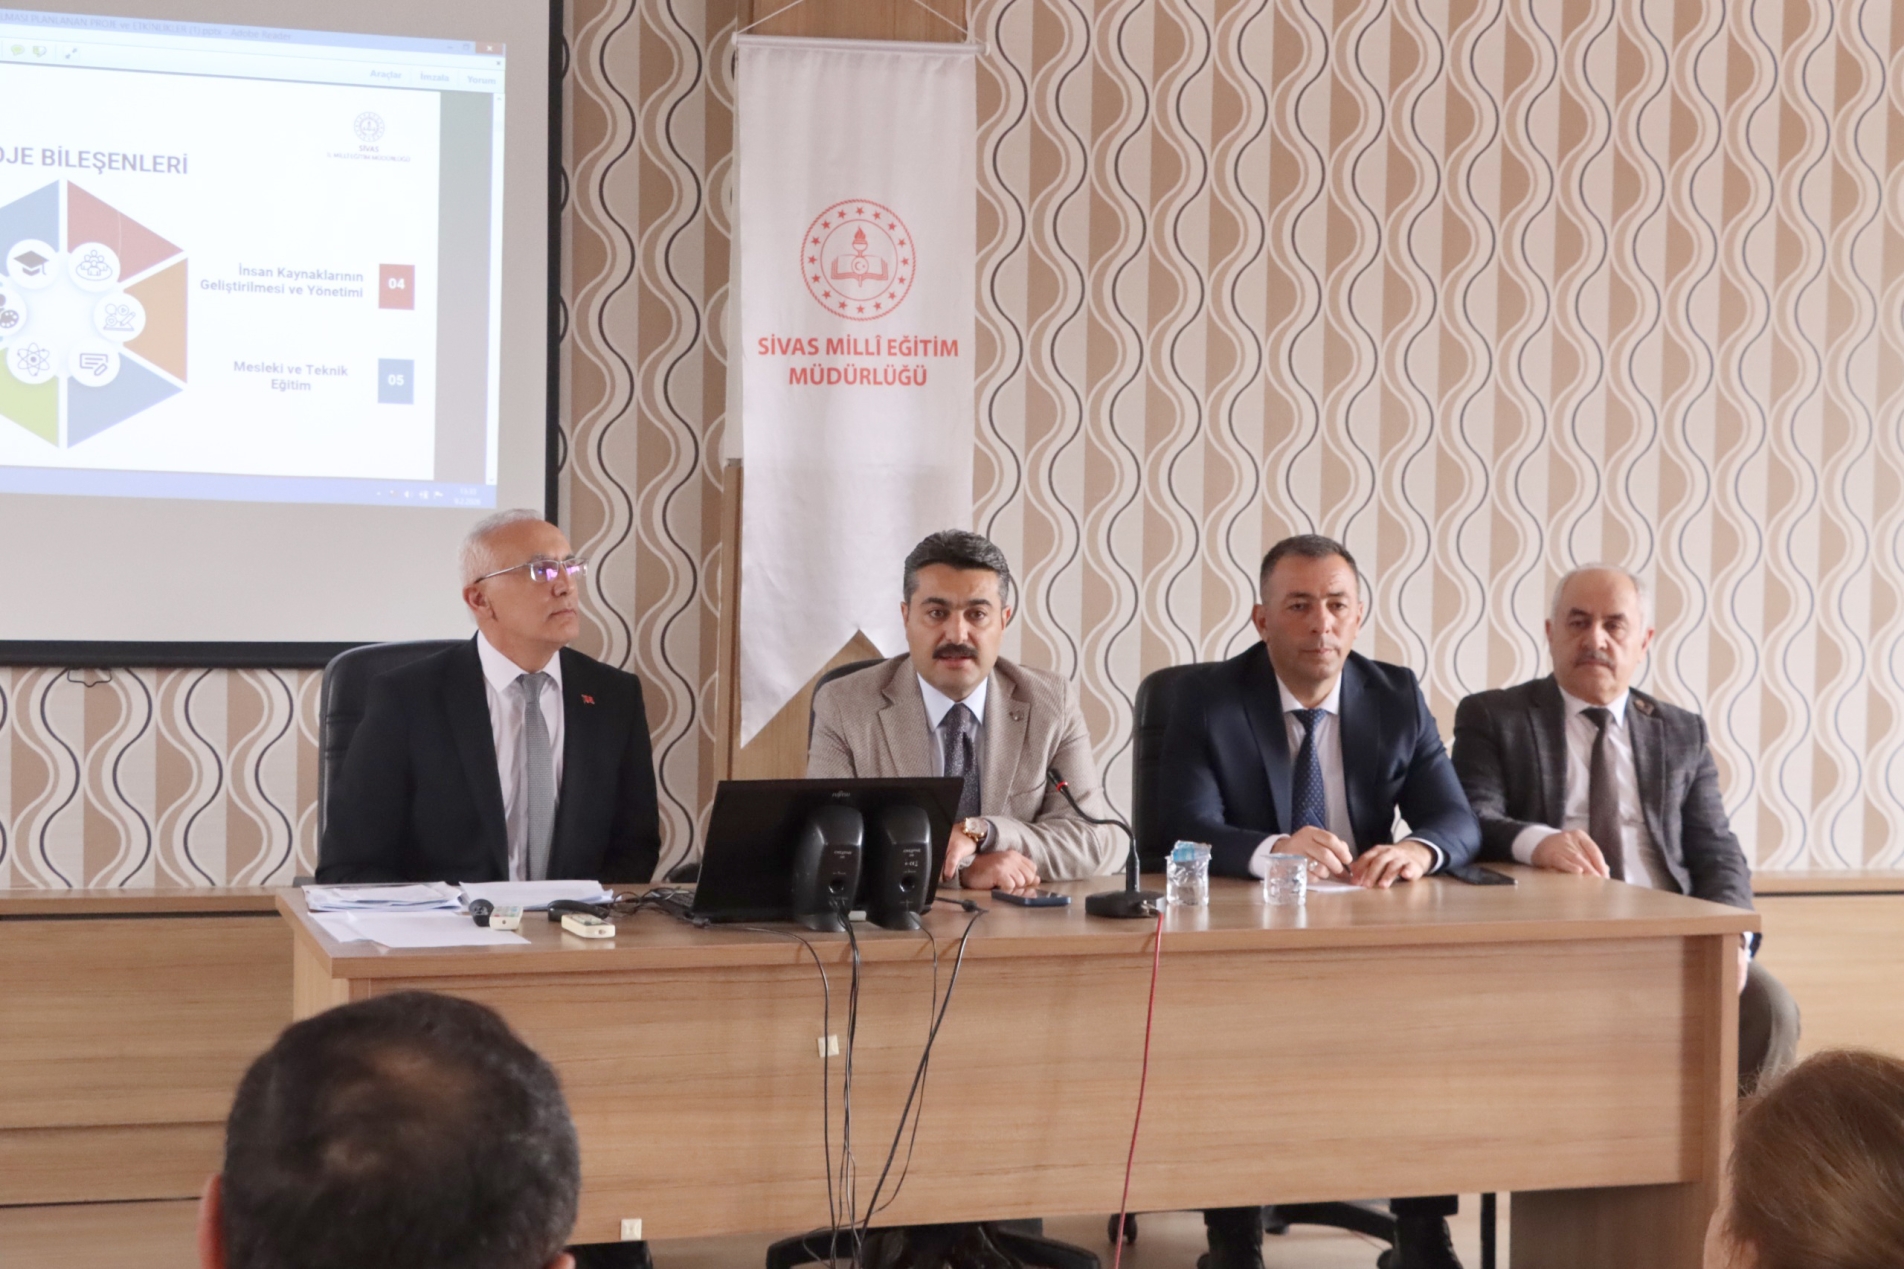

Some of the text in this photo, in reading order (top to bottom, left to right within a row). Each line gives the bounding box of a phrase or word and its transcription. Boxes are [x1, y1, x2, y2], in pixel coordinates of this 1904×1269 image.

[30, 15, 87, 26] PLANLANAN
[90, 18, 117, 29] PROJE
[119, 22, 130, 30] ve
[231, 28, 259, 39] Adobe
[262, 30, 291, 40] Reader
[370, 69, 402, 81] Araçlar
[420, 71, 450, 82] İmzala
[467, 75, 496, 85] Yorum
[41, 145, 188, 175] BİLEŞENLERİ
[238, 262, 364, 283] İnsan Kaynaklarının
[199, 278, 363, 298] Geliştirilmesi ve Yönetimi
[388, 277, 405, 290] 04
[757, 334, 819, 356] SİVAS
[887, 335, 958, 357] EĞİTİM
[233, 361, 348, 377] Mesleki ve Teknik
[789, 363, 927, 386] MÜDÜRLÜĞÜ
[271, 378, 311, 392] Eğitim
[388, 374, 404, 386] 05
